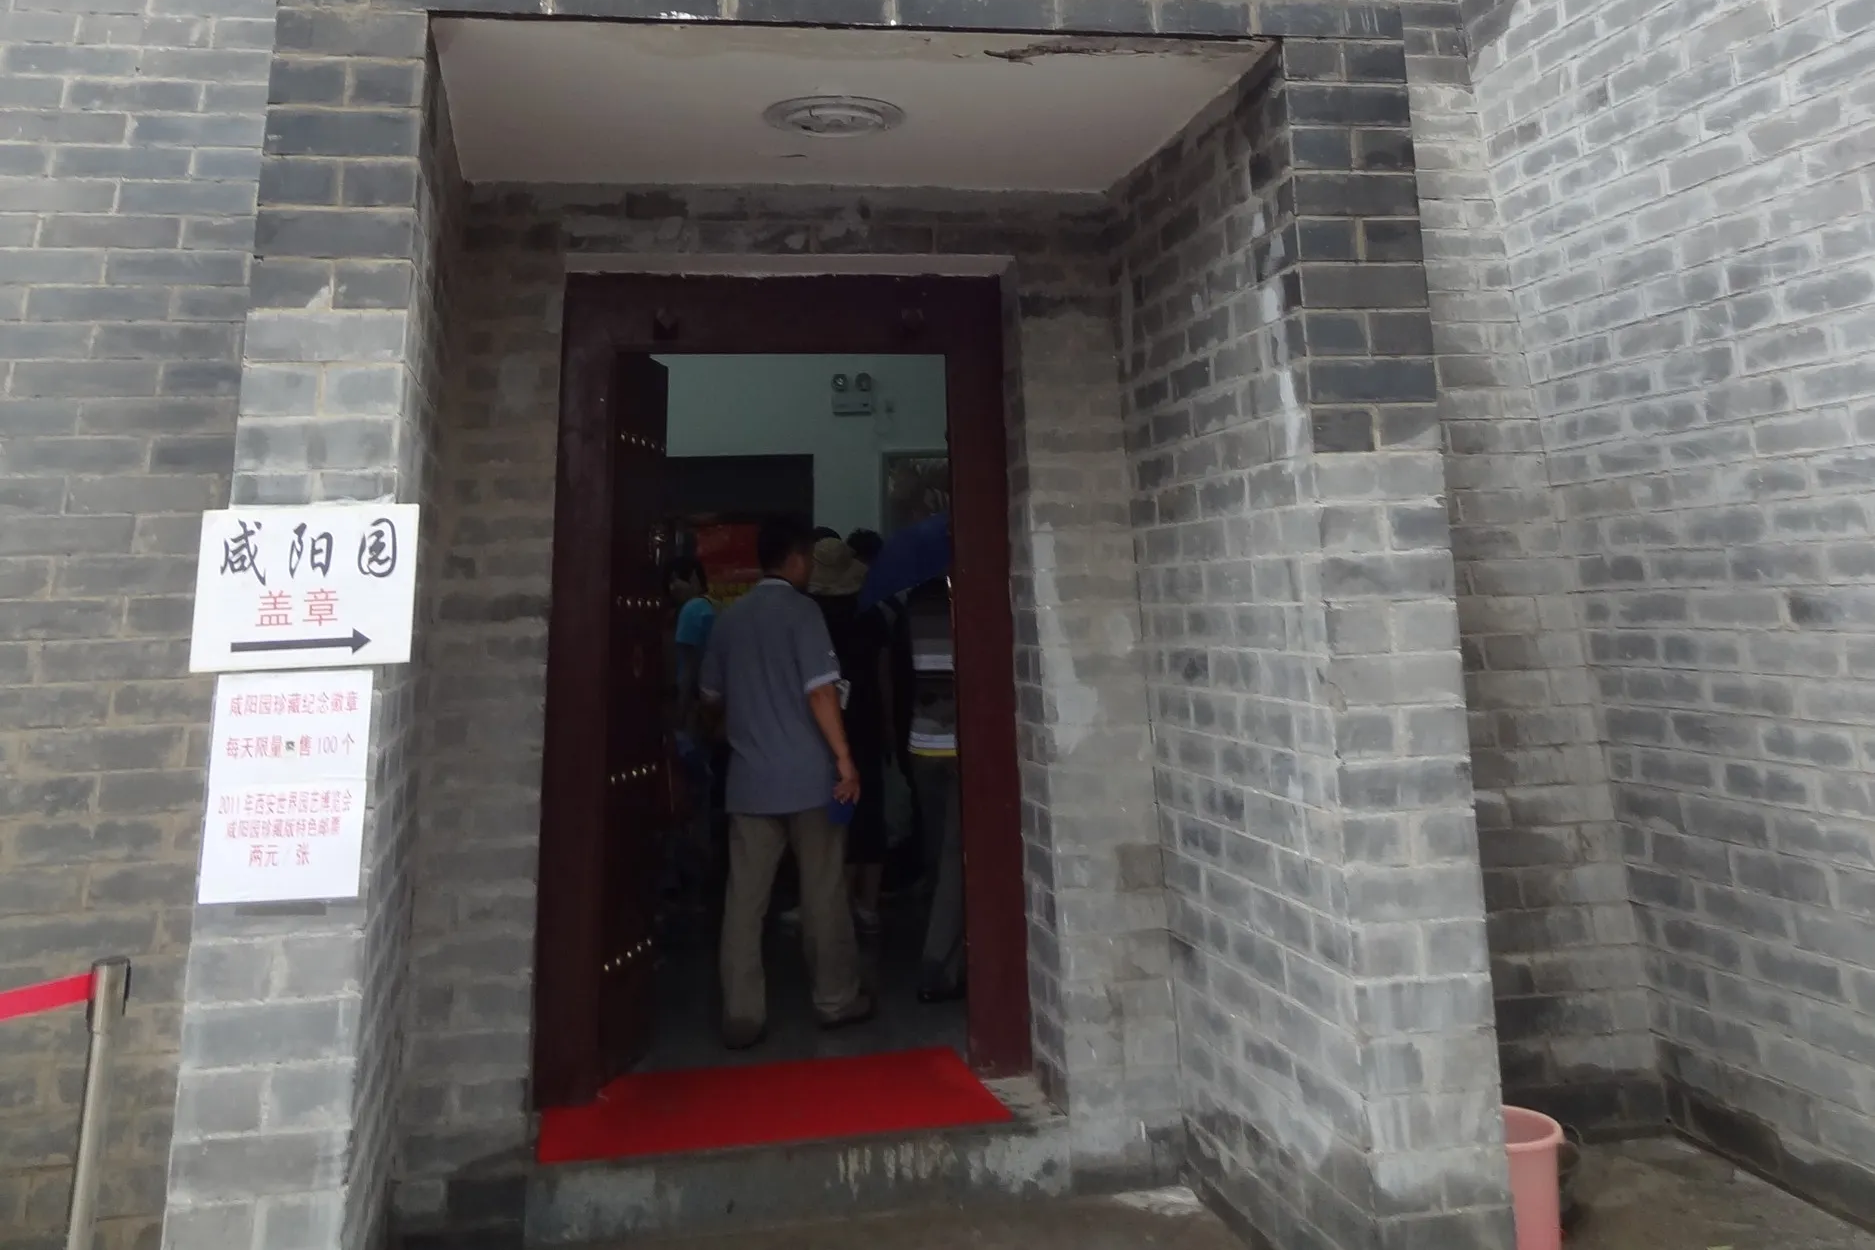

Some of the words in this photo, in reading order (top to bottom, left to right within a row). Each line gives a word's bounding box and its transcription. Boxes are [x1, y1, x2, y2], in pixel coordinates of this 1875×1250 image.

[220, 517, 397, 585] 咸阳园
[255, 588, 339, 626] 盖章
[229, 691, 359, 716] 咸阳园珍藏纪念徽章
